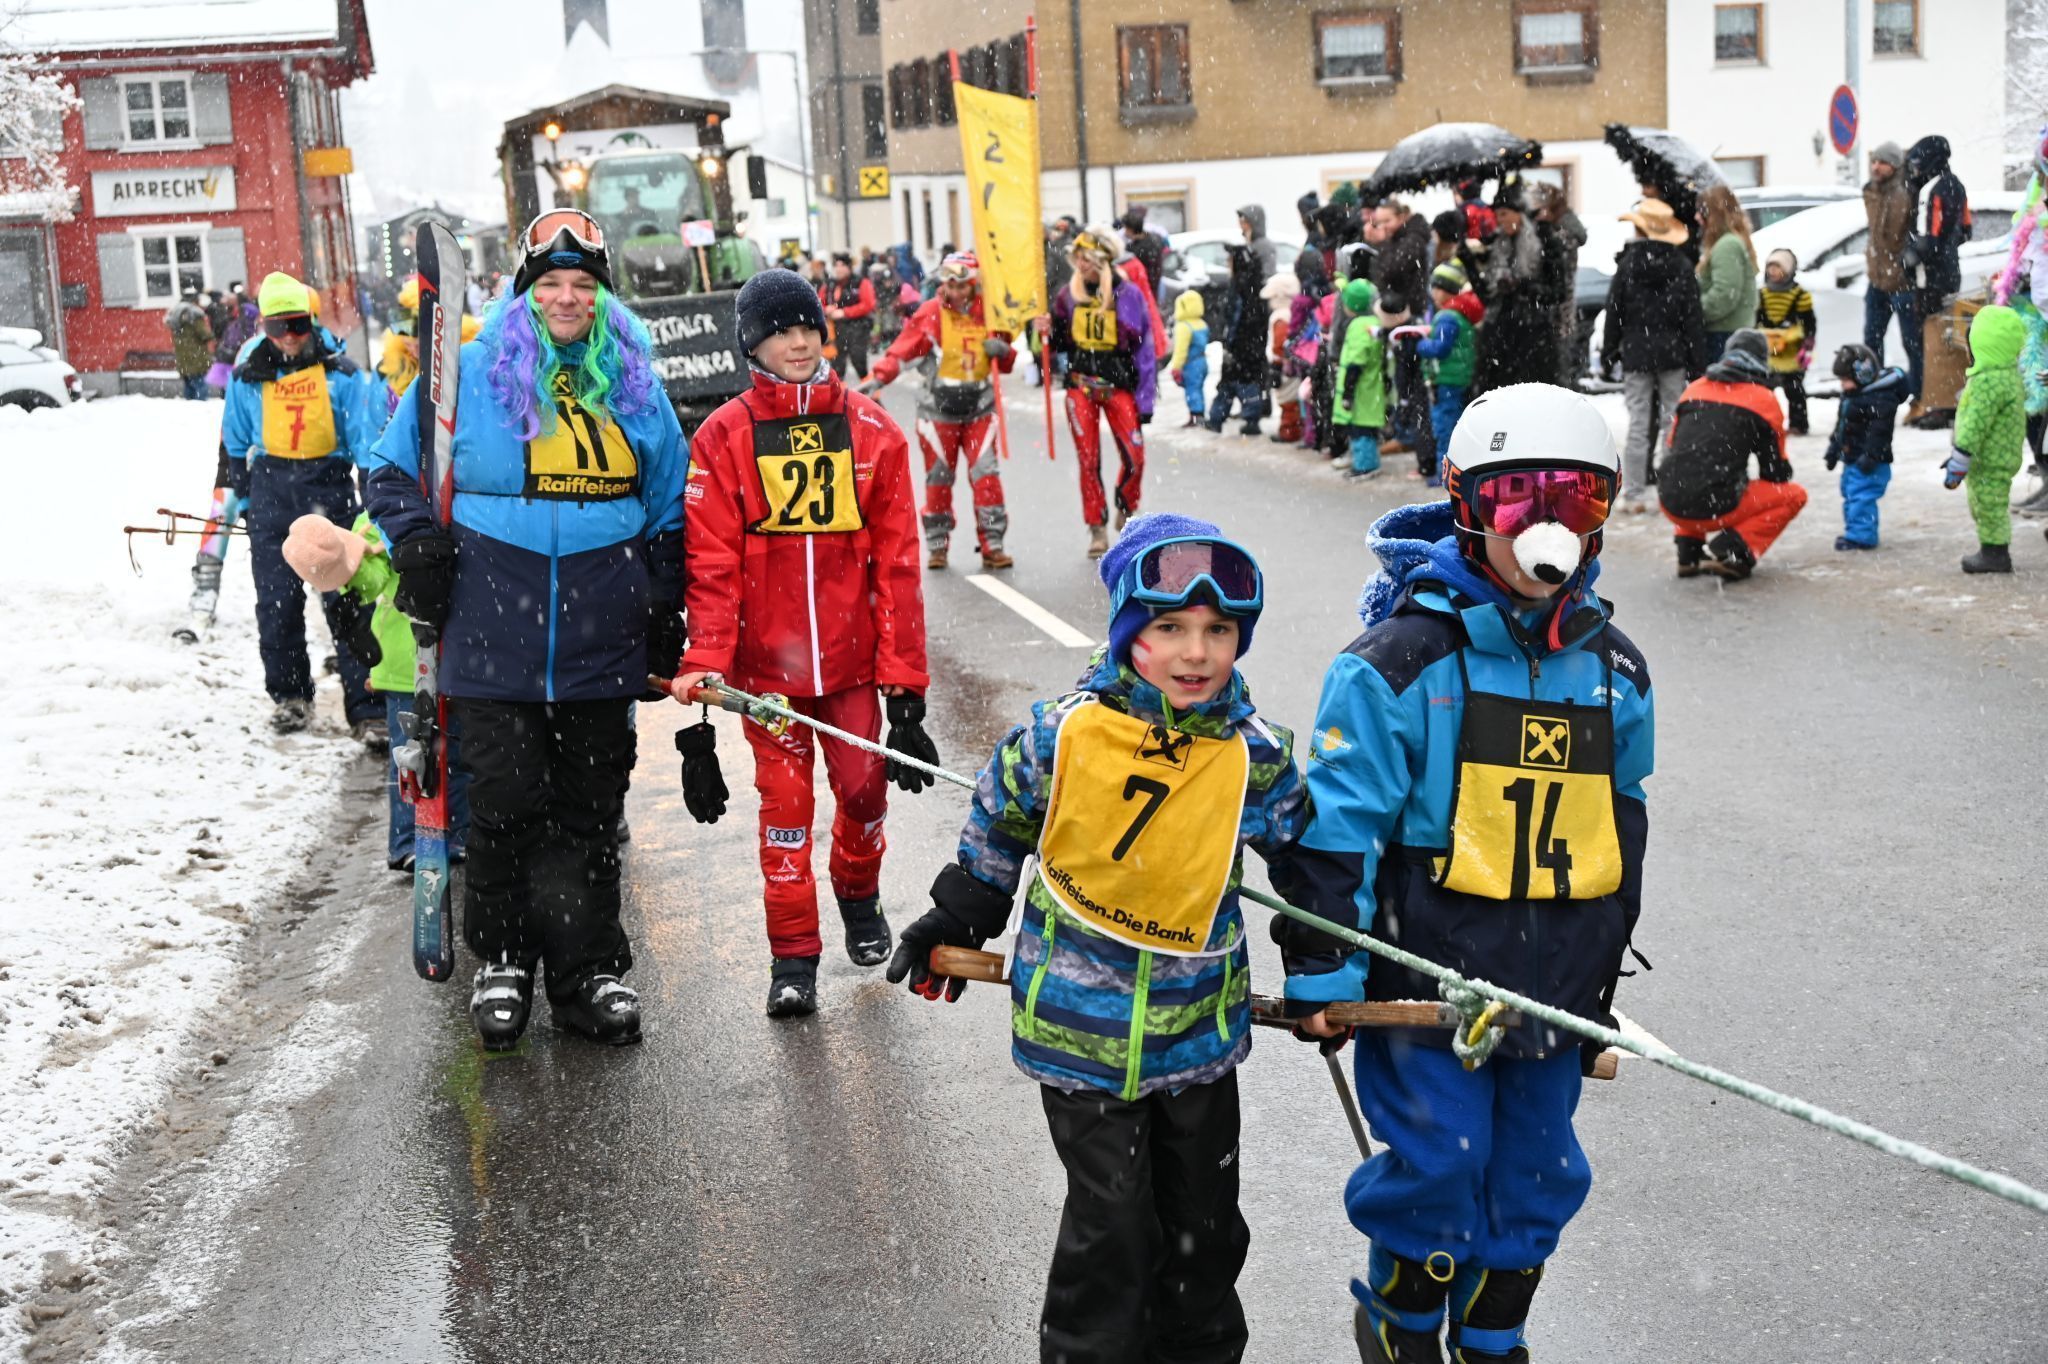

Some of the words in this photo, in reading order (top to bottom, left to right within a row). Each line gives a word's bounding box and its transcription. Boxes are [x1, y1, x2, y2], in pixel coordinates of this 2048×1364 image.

[431, 305, 445, 404] BLIZZARD
[962, 336, 976, 371] 5
[286, 405, 305, 451] 7
[537, 475, 630, 495] Raiffeisen
[777, 455, 835, 526] 23
[1112, 774, 1171, 862] 7
[1503, 777, 1573, 899] 14
[1144, 920, 1196, 944] Bank
